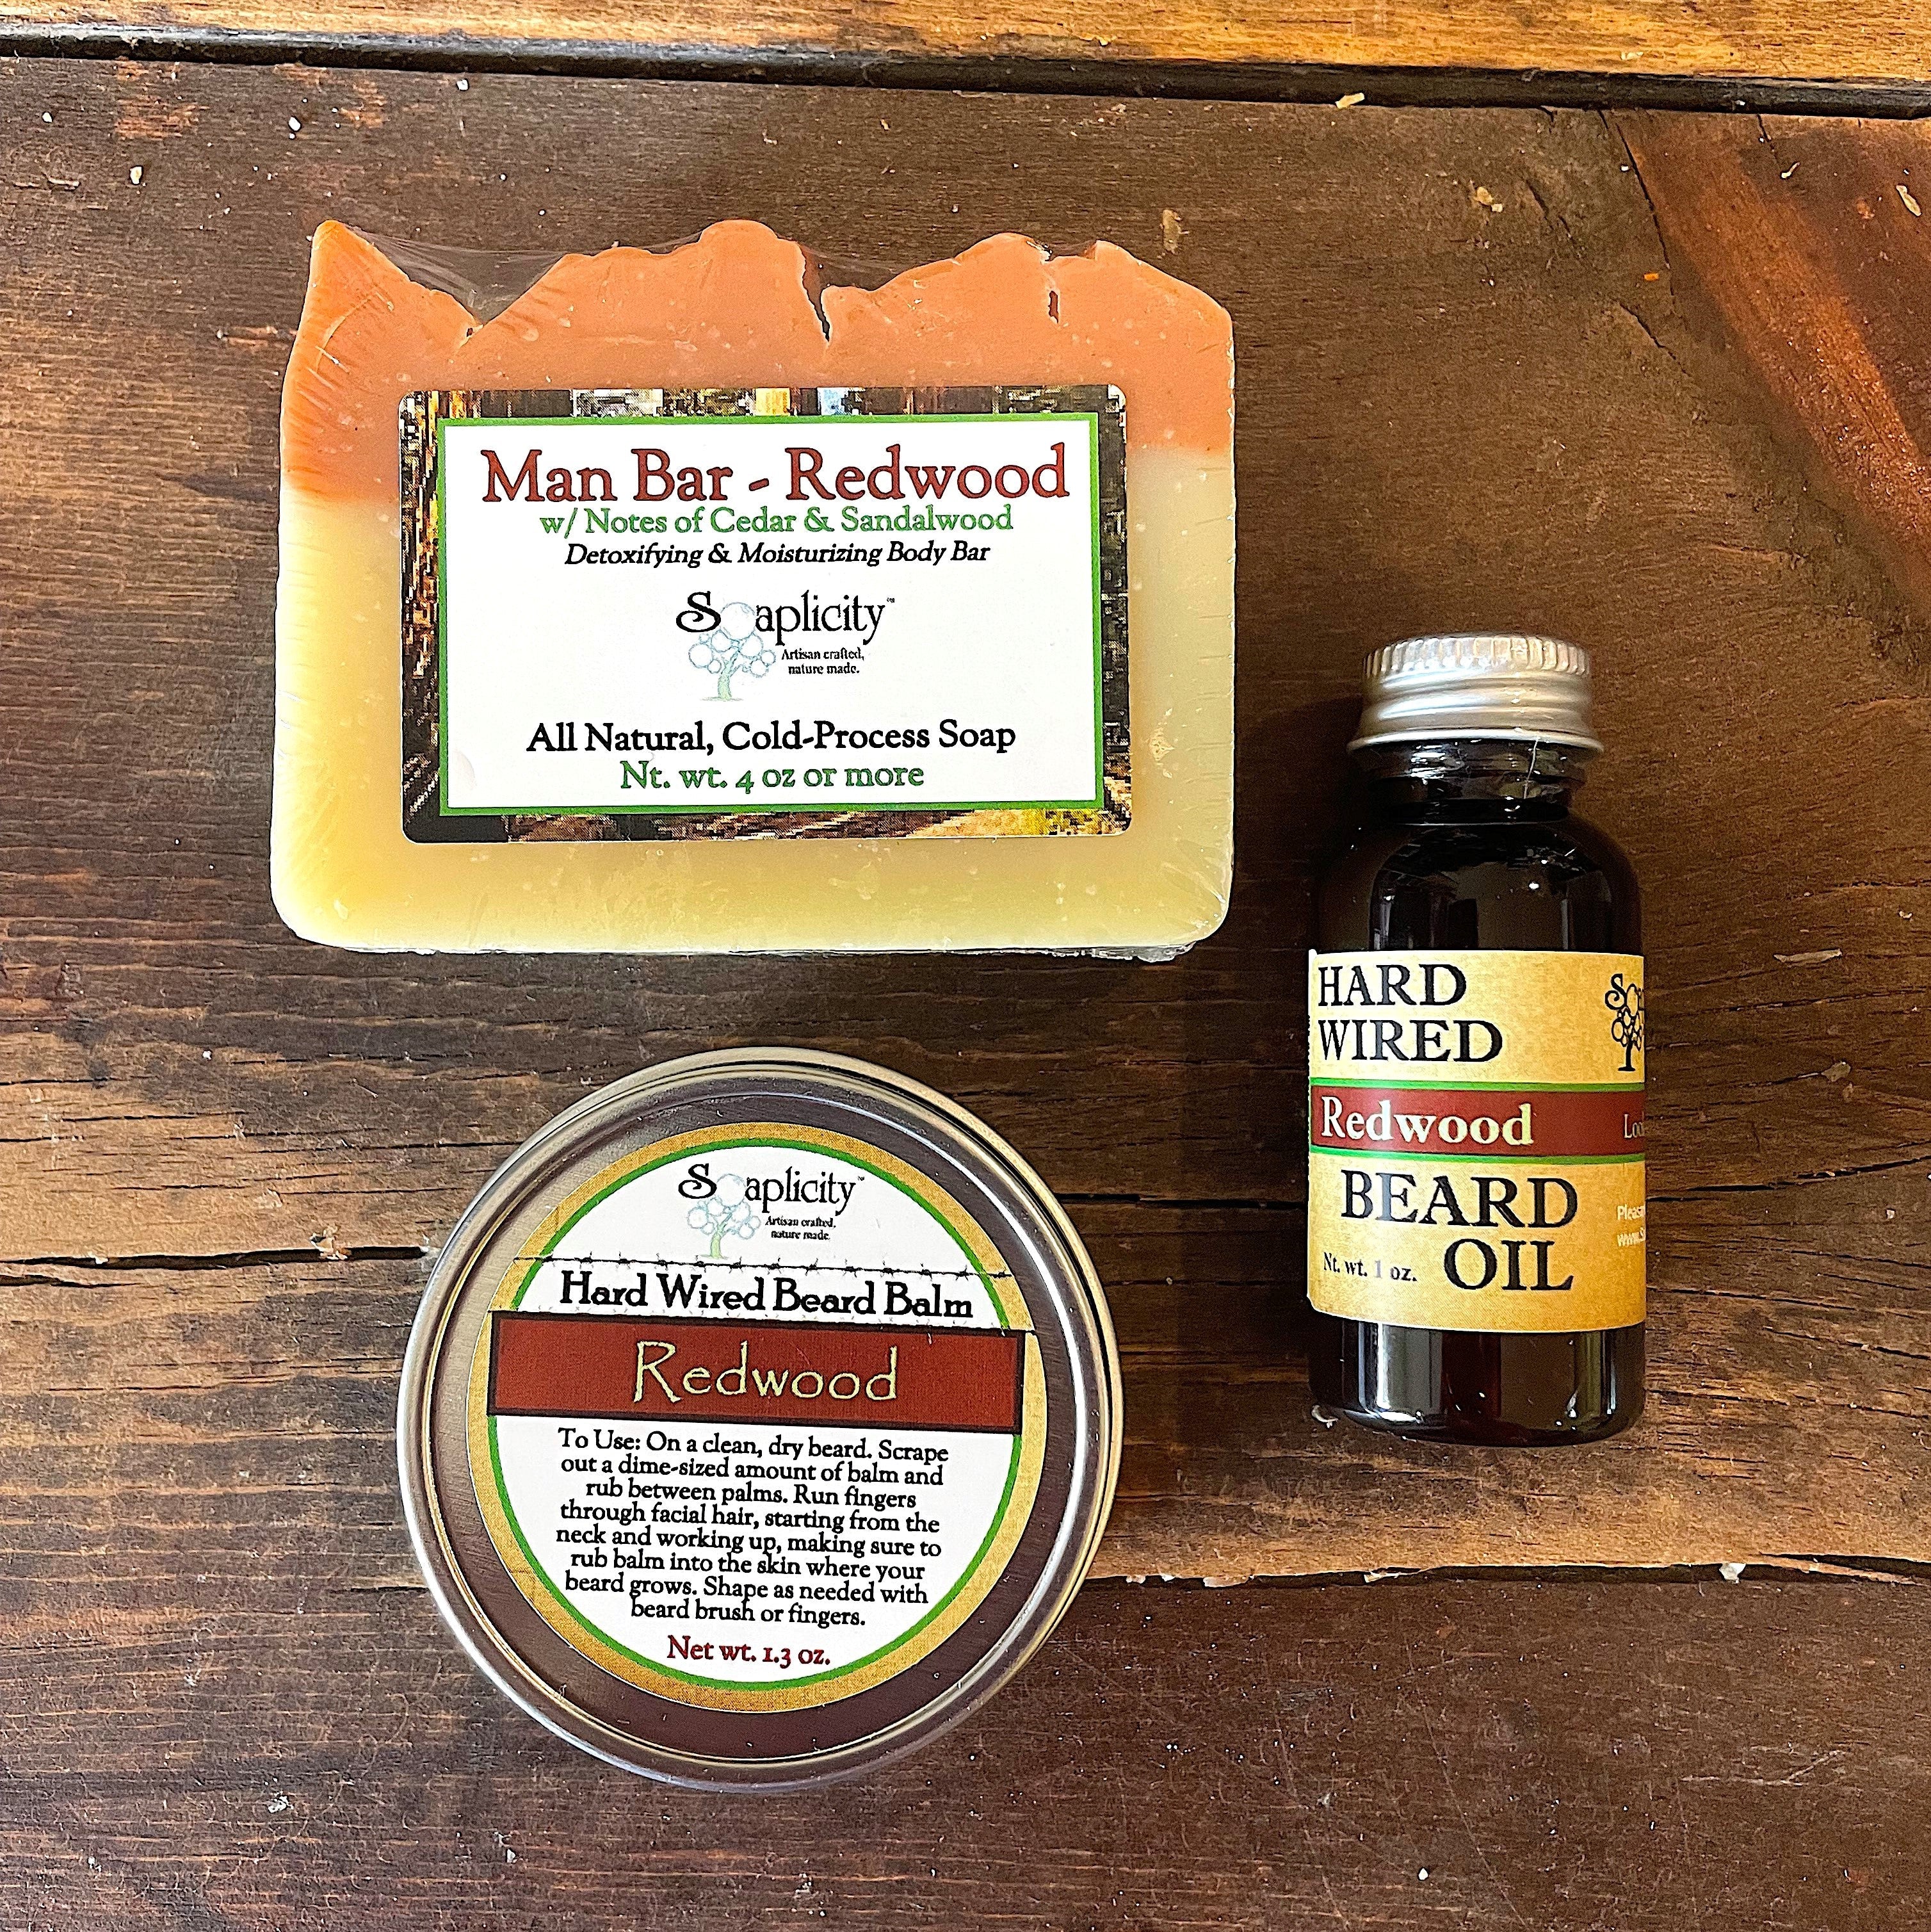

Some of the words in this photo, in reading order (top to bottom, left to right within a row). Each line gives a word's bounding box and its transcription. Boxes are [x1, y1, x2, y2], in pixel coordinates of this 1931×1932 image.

[481, 450, 618, 502] Man
[631, 448, 733, 501] Bar
[785, 442, 1070, 501] Redwood
[540, 508, 578, 539] w/
[584, 508, 667, 533] Notes
[675, 507, 705, 533] of
[711, 506, 796, 533] Cedar
[804, 507, 835, 532] &
[841, 504, 1013, 532] Sandalwood
[565, 542, 704, 568] Detoxifying
[708, 542, 732, 564] &
[738, 542, 883, 567] Moisturizing
[886, 540, 946, 565] Body
[950, 540, 990, 560] Bar
[782, 648, 820, 660] Artisan
[823, 647, 864, 660] crafted,
[788, 665, 823, 674] nature
[827, 662, 859, 674] made.
[526, 722, 578, 751] All
[585, 720, 713, 756] Natural,
[723, 720, 930, 750] Cold-Process
[939, 719, 1015, 753] Soap
[620, 761, 670, 788] Nt.
[679, 767, 727, 788] wt.
[736, 770, 754, 794] 4
[763, 769, 795, 787] oz
[804, 768, 837, 786] or
[844, 768, 924, 786] more
[1318, 964, 1466, 1007] HARD
[1319, 1020, 1503, 1062] WIRED
[1321, 1096, 1534, 1146] Redwood
[1341, 1169, 1578, 1228] BEARD
[1323, 1252, 1340, 1272] Nt.
[1345, 1260, 1368, 1277] wt.
[1375, 1260, 1382, 1278] 1
[1390, 1266, 1417, 1281] oz.
[1444, 1239, 1573, 1290] OIL
[560, 1270, 648, 1306] Hard
[656, 1273, 766, 1310] Wired
[773, 1278, 876, 1315] Beard
[884, 1281, 973, 1318] Balm
[634, 1340, 896, 1403] Redwood
[558, 1427, 588, 1448] To
[594, 1429, 640, 1450] Use:
[647, 1431, 681, 1451] On
[687, 1439, 697, 1452] a
[703, 1433, 762, 1457] clean,
[769, 1434, 804, 1460] dry
[809, 1436, 872, 1458] beard.
[878, 1440, 948, 1465] Scrape
[562, 1457, 597, 1472] out
[602, 1460, 613, 1473] a
[618, 1453, 729, 1477] dime-sized
[735, 1465, 816, 1480] amount
[821, 1461, 844, 1481] of
[848, 1461, 899, 1482] balm
[905, 1465, 943, 1485] and
[586, 1476, 622, 1497] rub
[628, 1477, 716, 1500] between
[722, 1481, 788, 1506] palms.
[793, 1484, 839, 1504] Run
[844, 1486, 916, 1511] fingers
[561, 1498, 646, 1526] through
[651, 1502, 707, 1523] facial
[711, 1509, 759, 1529] hair,
[765, 1510, 844, 1534] starting
[850, 1509, 900, 1531] from
[906, 1511, 939, 1532] the
[556, 1523, 606, 1543] neck
[612, 1525, 651, 1545] and
[656, 1527, 743, 1554] working
[749, 1537, 781, 1554] up,
[788, 1532, 865, 1558] making
[871, 1541, 914, 1555] sure
[920, 1541, 941, 1556] to
[570, 1547, 607, 1568] rub
[613, 1547, 665, 1569] balm
[670, 1552, 713, 1571] into
[718, 1552, 752, 1573] the
[757, 1554, 801, 1575] skin
[806, 1555, 870, 1577] where
[875, 1566, 925, 1582] your
[565, 1570, 624, 1592] beard
[629, 1581, 697, 1599] grows.
[704, 1575, 768, 1602] Shape
[774, 1585, 793, 1598] as
[800, 1580, 875, 1602] needed
[880, 1583, 928, 1603] with
[631, 1598, 690, 1618] beard
[695, 1599, 755, 1621] brush
[761, 1609, 784, 1621] or
[788, 1602, 865, 1628] fingers.
[667, 1635, 714, 1660] Net
[719, 1644, 756, 1662] wt.
[763, 1648, 791, 1669] 1.3
[798, 1650, 830, 1665] oz.
